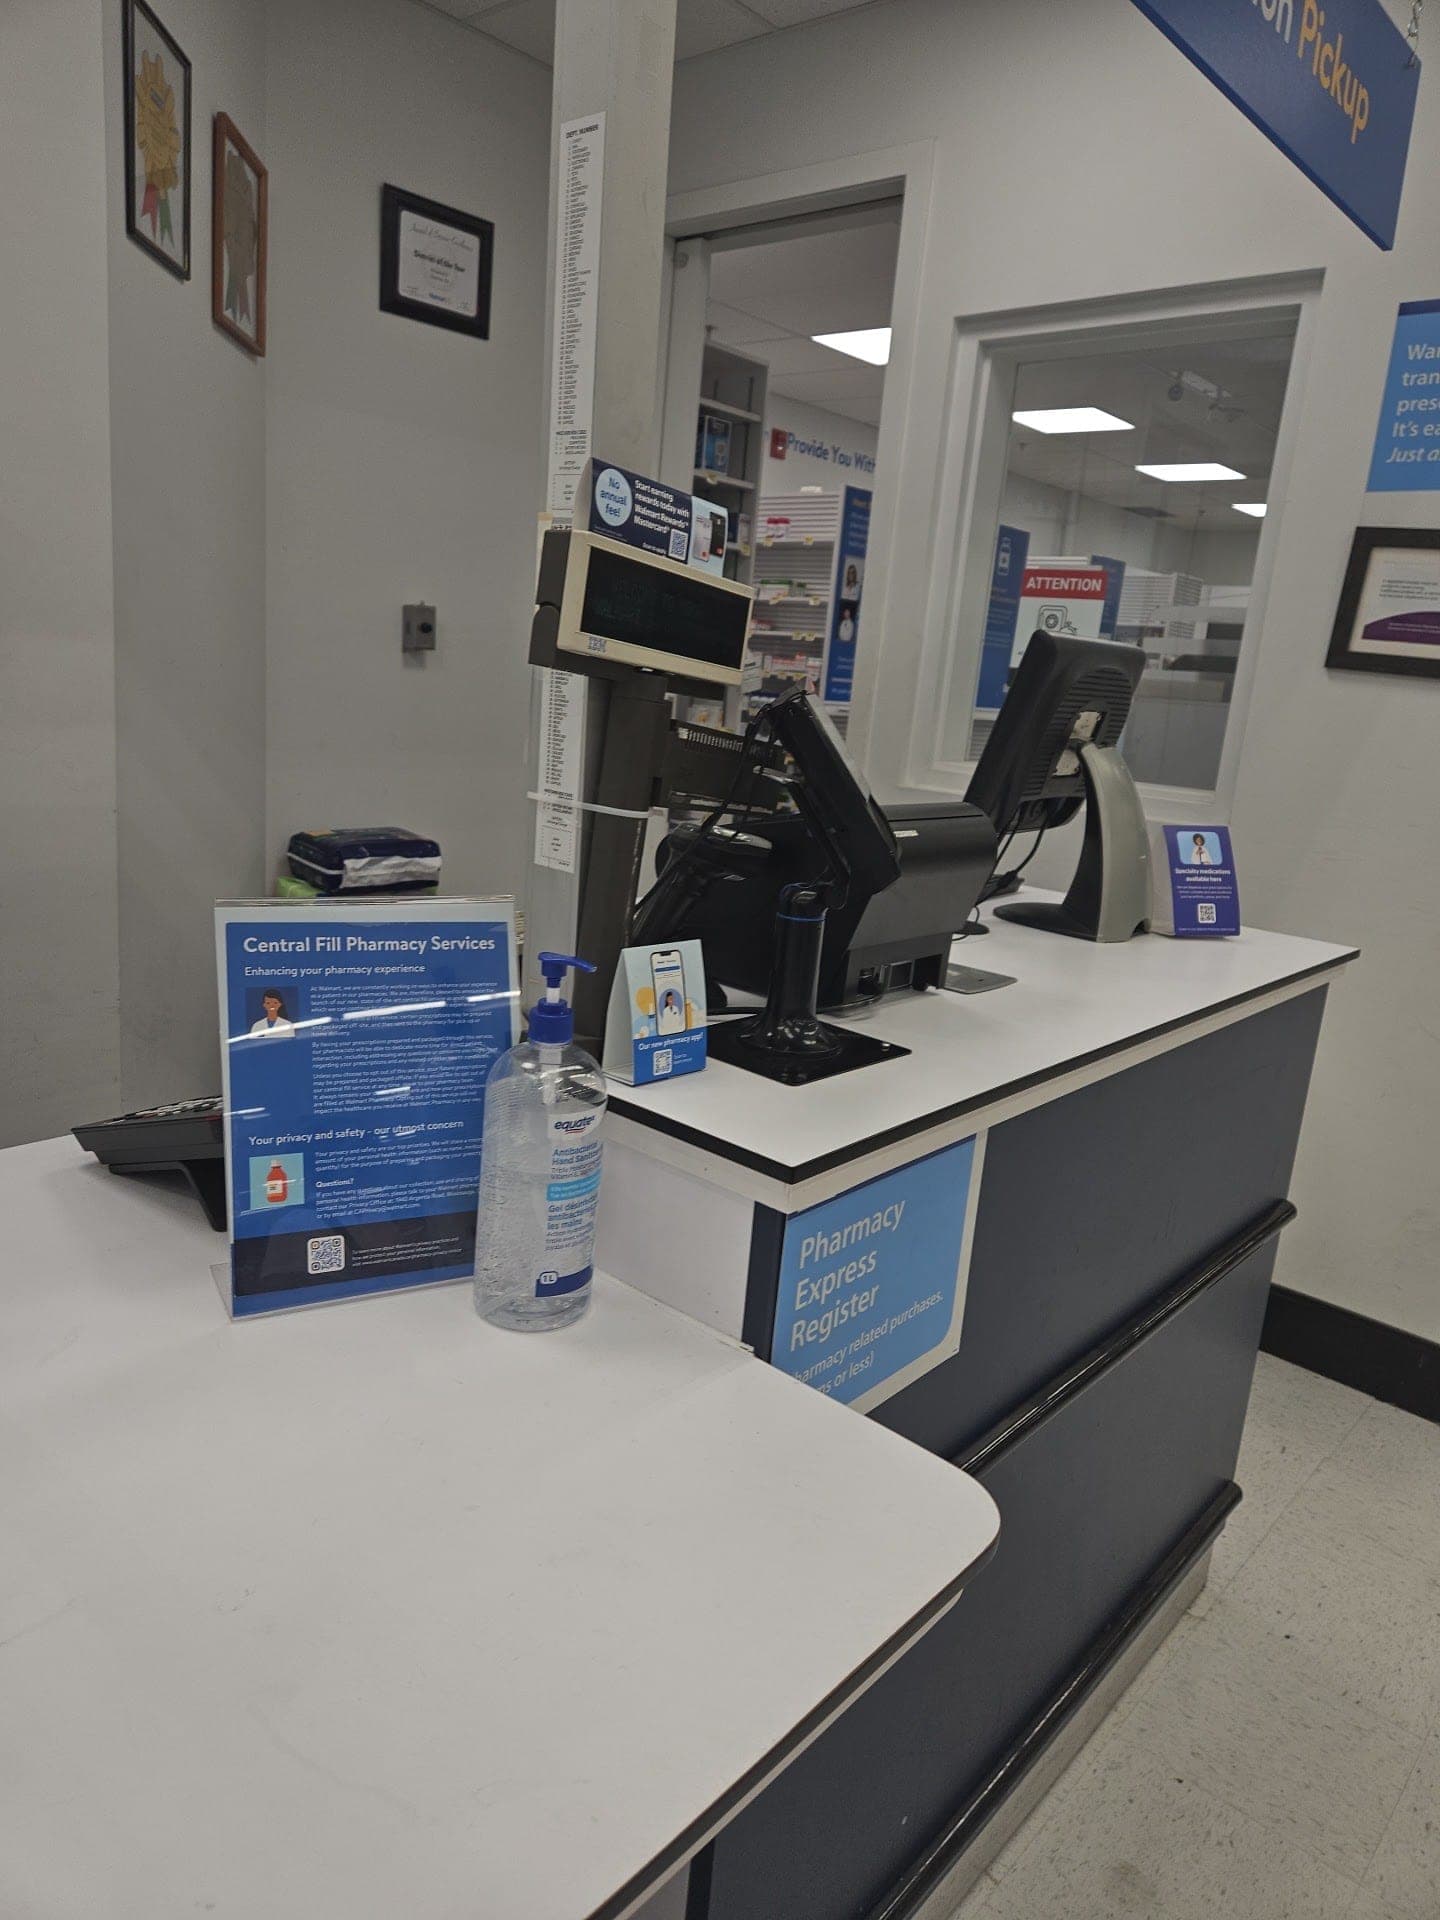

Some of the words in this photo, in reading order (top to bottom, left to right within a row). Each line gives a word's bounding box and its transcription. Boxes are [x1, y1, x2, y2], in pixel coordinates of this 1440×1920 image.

[1298, 0, 1369, 145] Pickup
[1392, 420, 1419, 438] It's
[788, 431, 830, 460] Provide
[831, 445, 852, 467] You
[1385, 447, 1425, 464] Just
[609, 477, 621, 490] No
[635, 480, 651, 493] Start
[651, 487, 674, 503] earning
[600, 489, 627, 506] annual
[635, 493, 659, 508] rewards
[660, 502, 677, 516] today
[677, 507, 690, 518] with
[606, 503, 621, 518] fee!
[634, 504, 661, 519] Walmart
[1026, 576, 1102, 592] ATTENTION
[243, 937, 310, 953] Central
[316, 937, 341, 952] Fill
[346, 936, 427, 955] Pharmacy
[431, 935, 496, 951] Services
[245, 965, 298, 978] Enhancing
[300, 967, 322, 977] your
[324, 964, 372, 977] pharmacy
[375, 963, 426, 975] experience
[664, 1036, 691, 1049] pharmacy
[248, 1136, 274, 1147] Your
[275, 1132, 313, 1147] privacy
[315, 1130, 334, 1141] and
[335, 1127, 366, 1140] safety
[374, 1127, 391, 1136] our
[393, 1122, 426, 1136] utmost
[428, 1120, 465, 1132] concern
[315, 1178, 354, 1188] Questions?
[799, 1200, 906, 1270] Pharmacy
[794, 1250, 878, 1311] Express
[790, 1284, 880, 1353] Register
[849, 1319, 889, 1355] related
[890, 1290, 944, 1336] purchases.
[835, 1370, 847, 1389] or
[849, 1350, 875, 1379] less)
